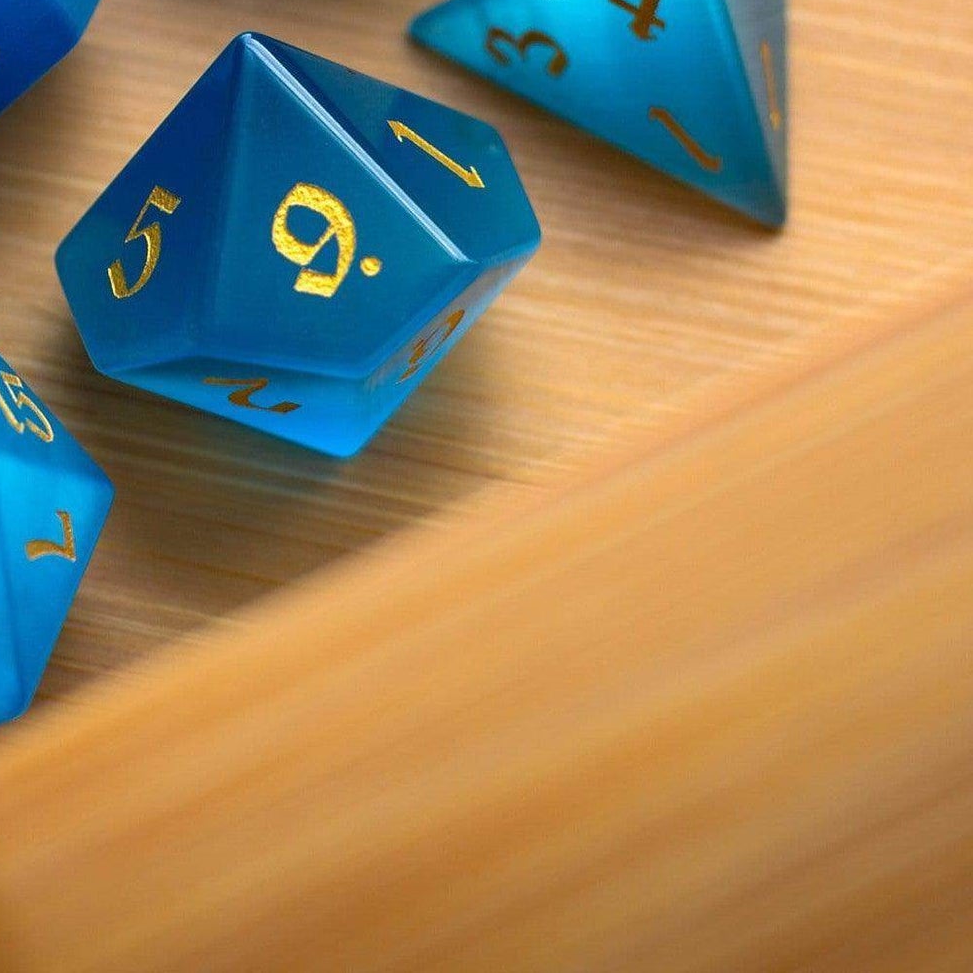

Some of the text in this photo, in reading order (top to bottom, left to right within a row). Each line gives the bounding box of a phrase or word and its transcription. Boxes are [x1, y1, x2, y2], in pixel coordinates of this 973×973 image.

[483, 24, 571, 79] 3
[385, 119, 487, 190] 1
[647, 105, 722, 173] 1
[106, 183, 183, 300] 5
[26, 509, 77, 563] 7
